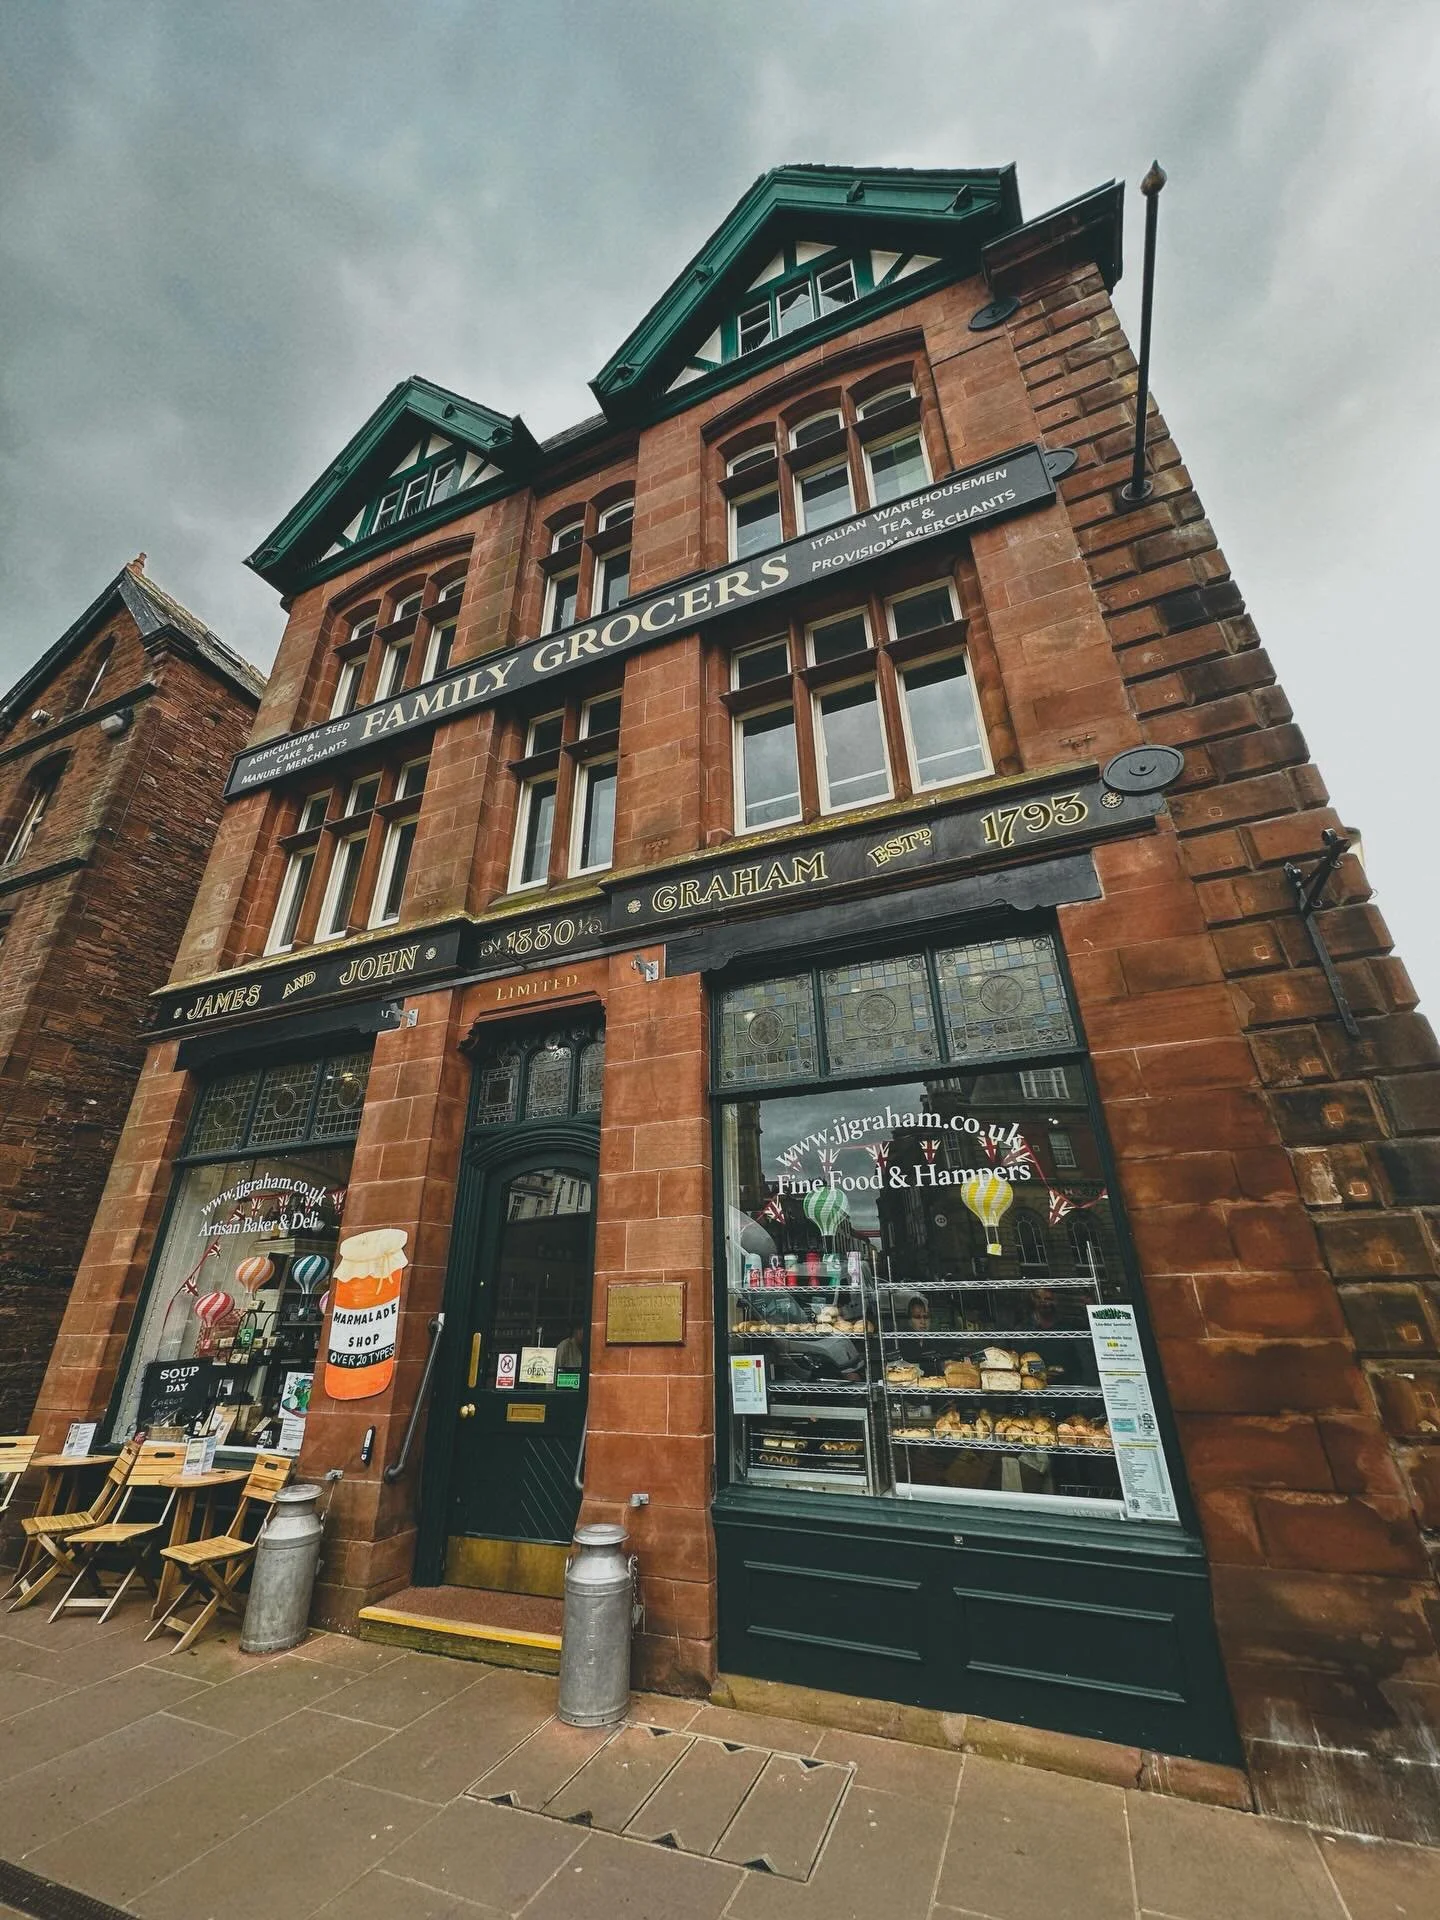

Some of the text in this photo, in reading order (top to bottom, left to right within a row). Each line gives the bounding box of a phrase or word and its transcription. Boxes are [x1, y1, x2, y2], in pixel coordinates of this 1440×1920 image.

[811, 469, 1007, 551] ITALIAN WAREHOUSEMEN
[879, 508, 935, 536] TEA &
[906, 489, 1016, 538] MERCHANTS
[359, 554, 789, 741] FAMILY GROCERS
[248, 722, 350, 767] AGRICULTURAL SEED
[276, 744, 314, 764] CAKE &
[241, 739, 347, 784] MANURE MERCHANTS
[652, 852, 829, 913] GRAHAM
[980, 791, 1088, 847] 1793
[186, 945, 421, 1020] JAMES AND JOHN
[776, 1106, 1025, 1168] www.jjgraham.co.uk
[200, 1172, 327, 1216] www.jjgraham.co.uk
[777, 1163, 1031, 1196] Fine Food & Hampers
[198, 1211, 319, 1237] Artisan Baker & Deli
[333, 1303, 397, 1325] MARMALADE
[330, 1345, 395, 1366] OVER 20 TYPES
[348, 1333, 380, 1348] SHOP
[160, 1366, 199, 1380] SOUP
[166, 1383, 189, 1393] DAY
[527, 1367, 547, 1376] OPEN
